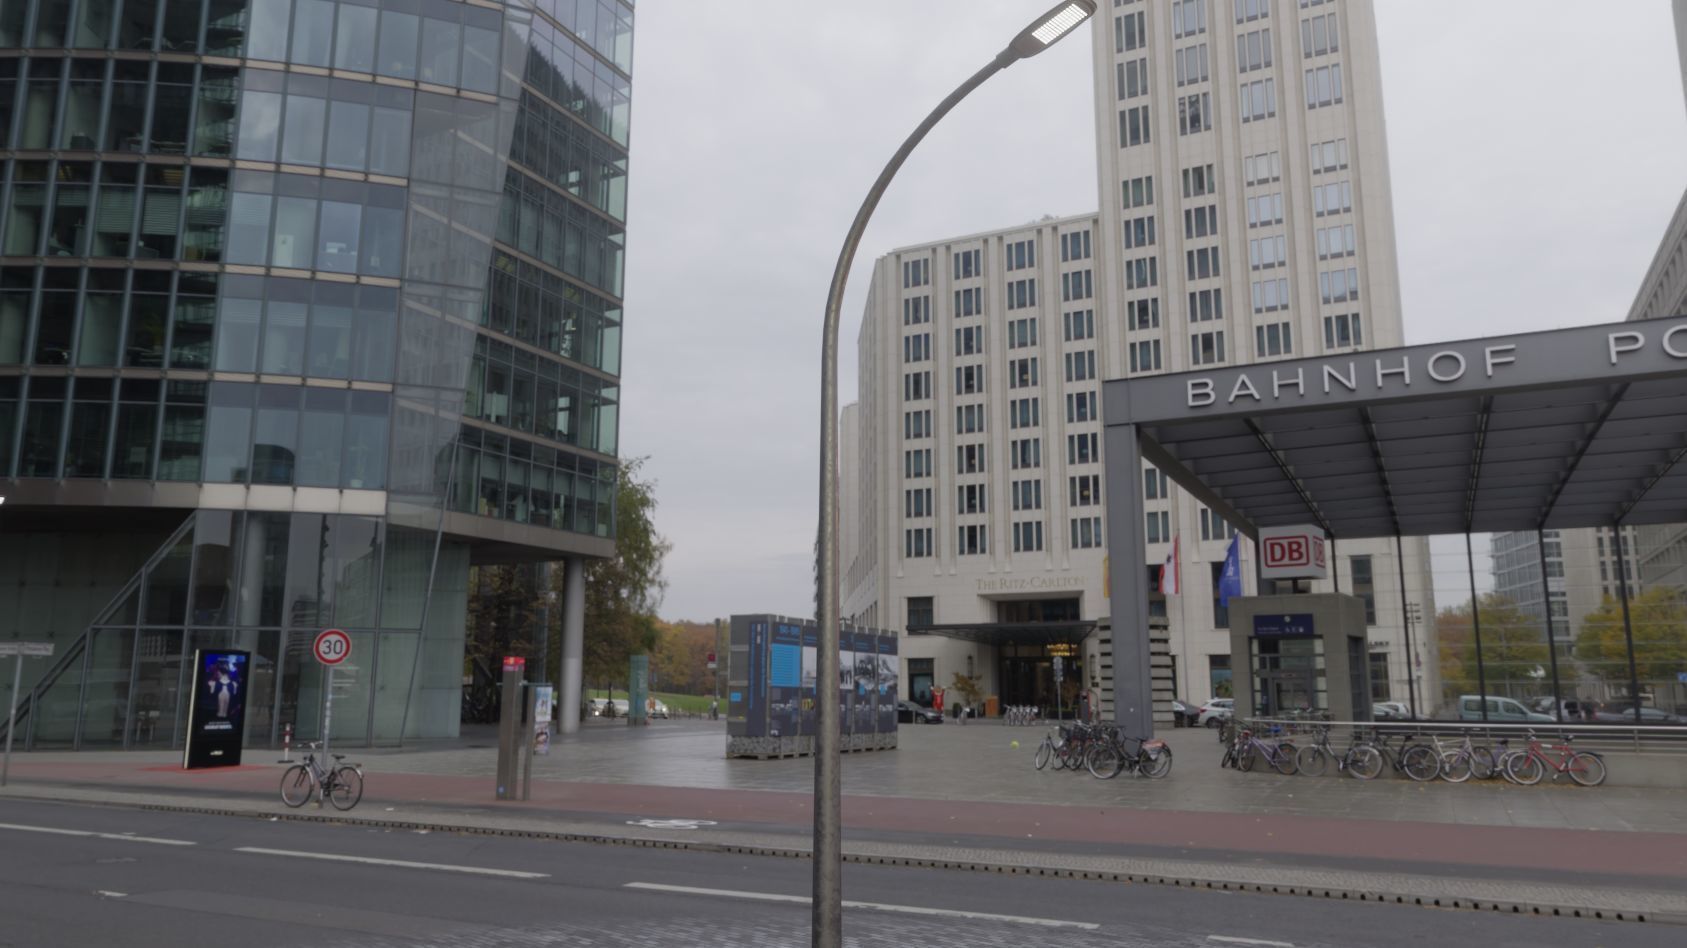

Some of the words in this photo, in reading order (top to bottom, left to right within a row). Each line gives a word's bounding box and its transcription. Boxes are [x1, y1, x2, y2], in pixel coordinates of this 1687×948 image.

[1187, 344, 1516, 408] BAHNHOF
[1269, 541, 1304, 562] DB
[322, 639, 343, 655] 30
